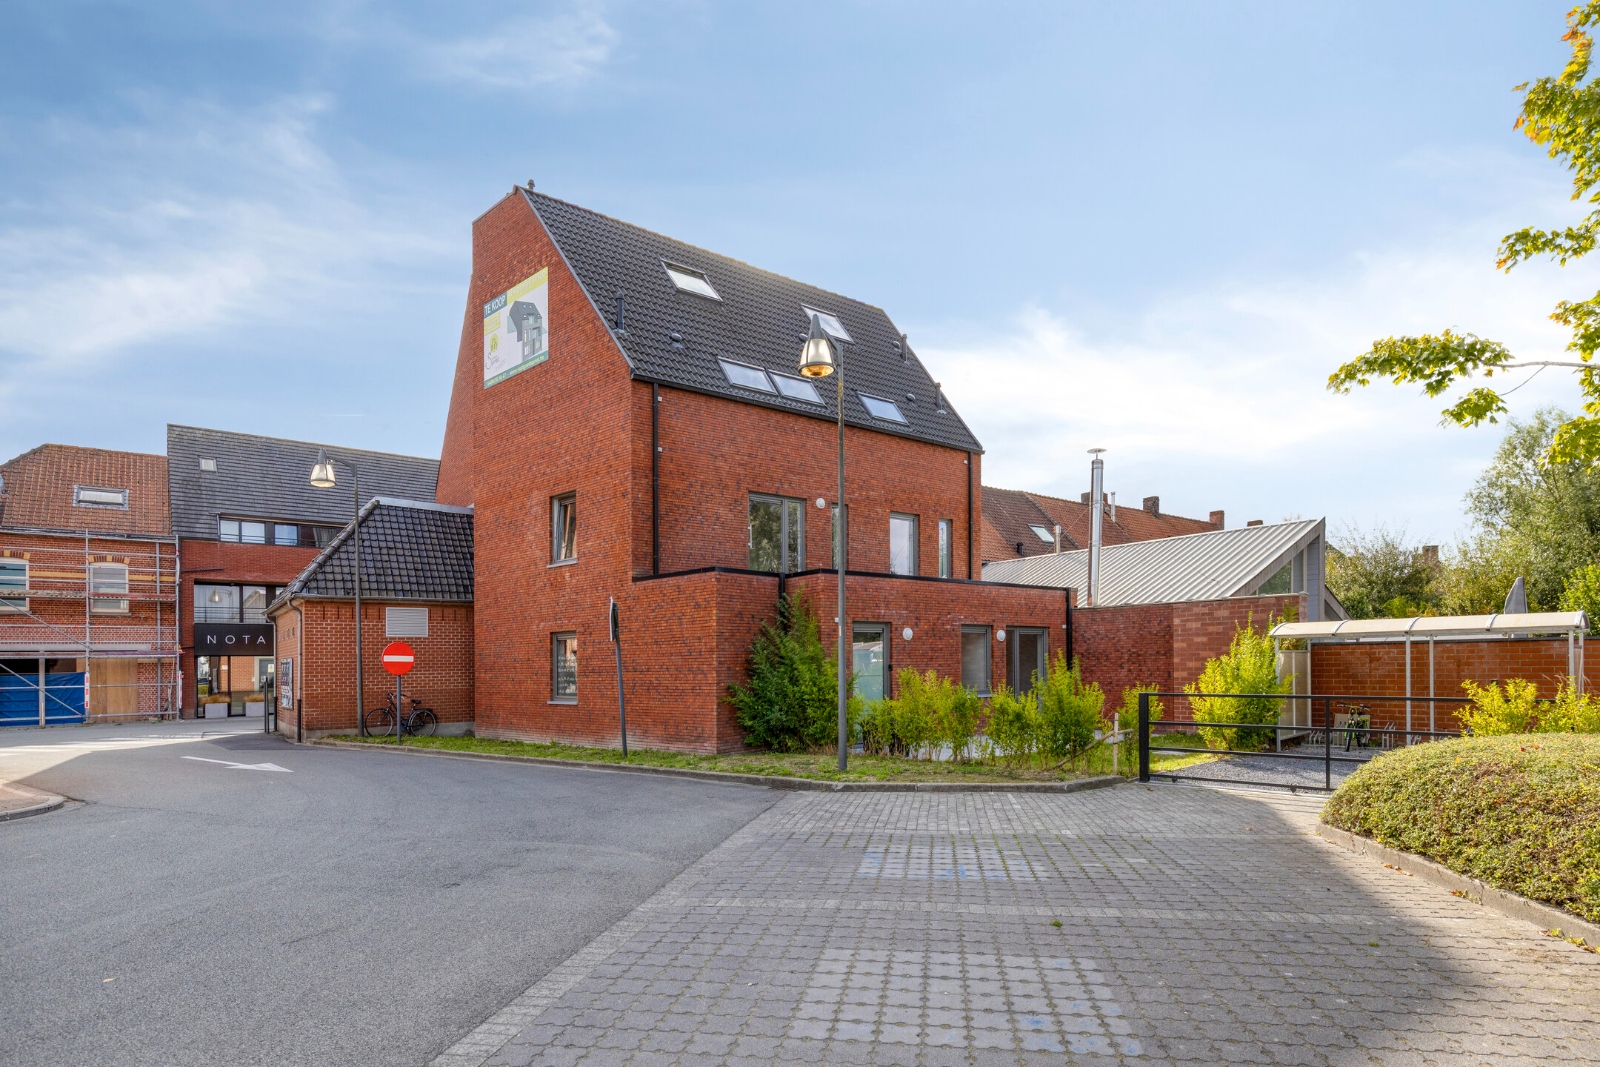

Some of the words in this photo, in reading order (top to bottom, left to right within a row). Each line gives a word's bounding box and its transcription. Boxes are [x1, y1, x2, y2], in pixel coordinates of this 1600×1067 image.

[485, 304, 491, 315] TE
[491, 295, 506, 312] KOOP
[207, 635, 266, 644] NOTA
